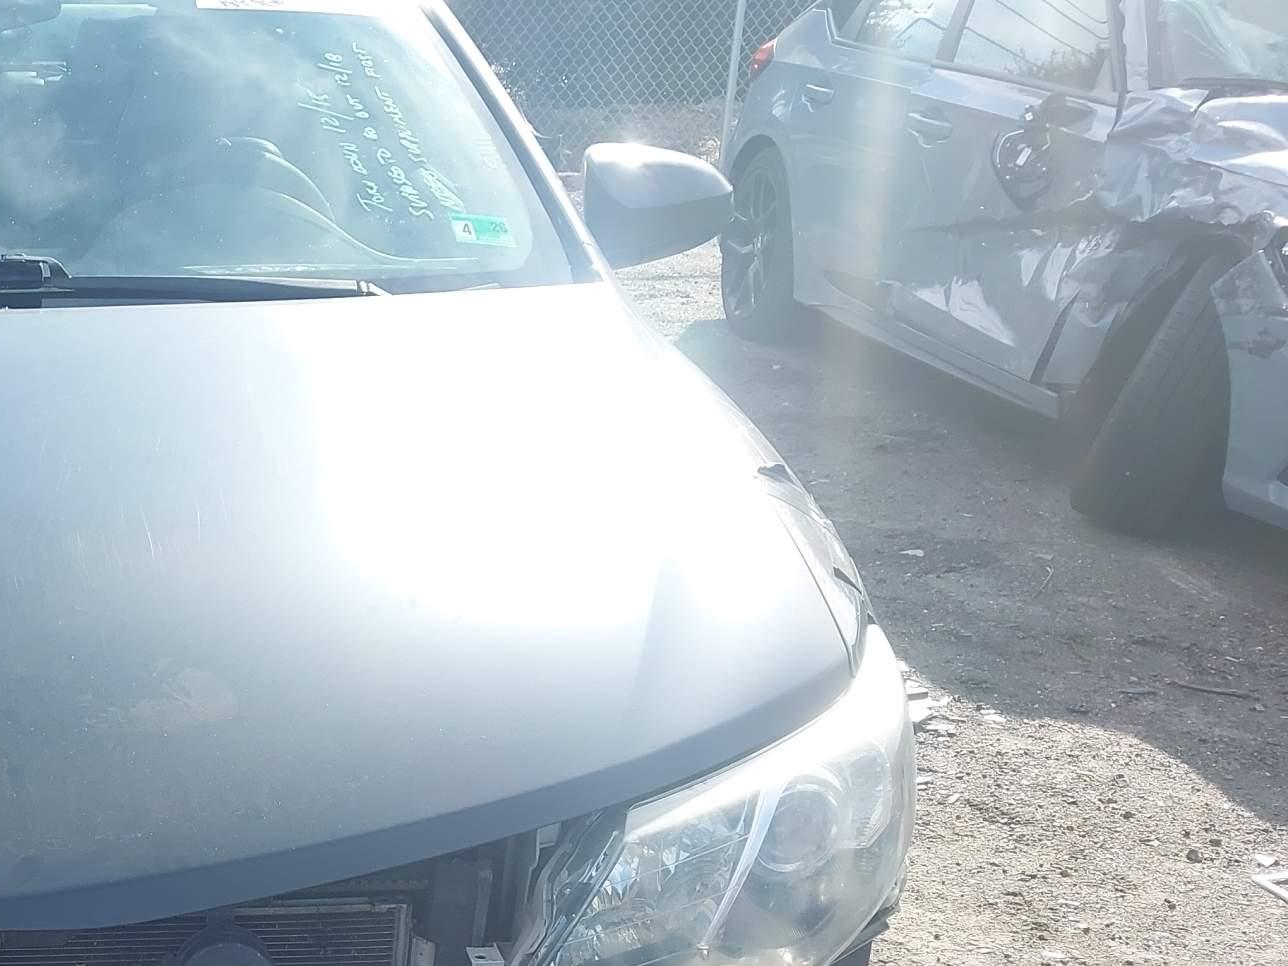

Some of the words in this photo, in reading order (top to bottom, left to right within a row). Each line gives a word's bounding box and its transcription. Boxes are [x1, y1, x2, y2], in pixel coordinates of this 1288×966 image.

[317, 53, 353, 86] 12/18
[298, 89, 354, 132] 12/15
[348, 95, 370, 120] OUT
[462, 223, 472, 235] 4
